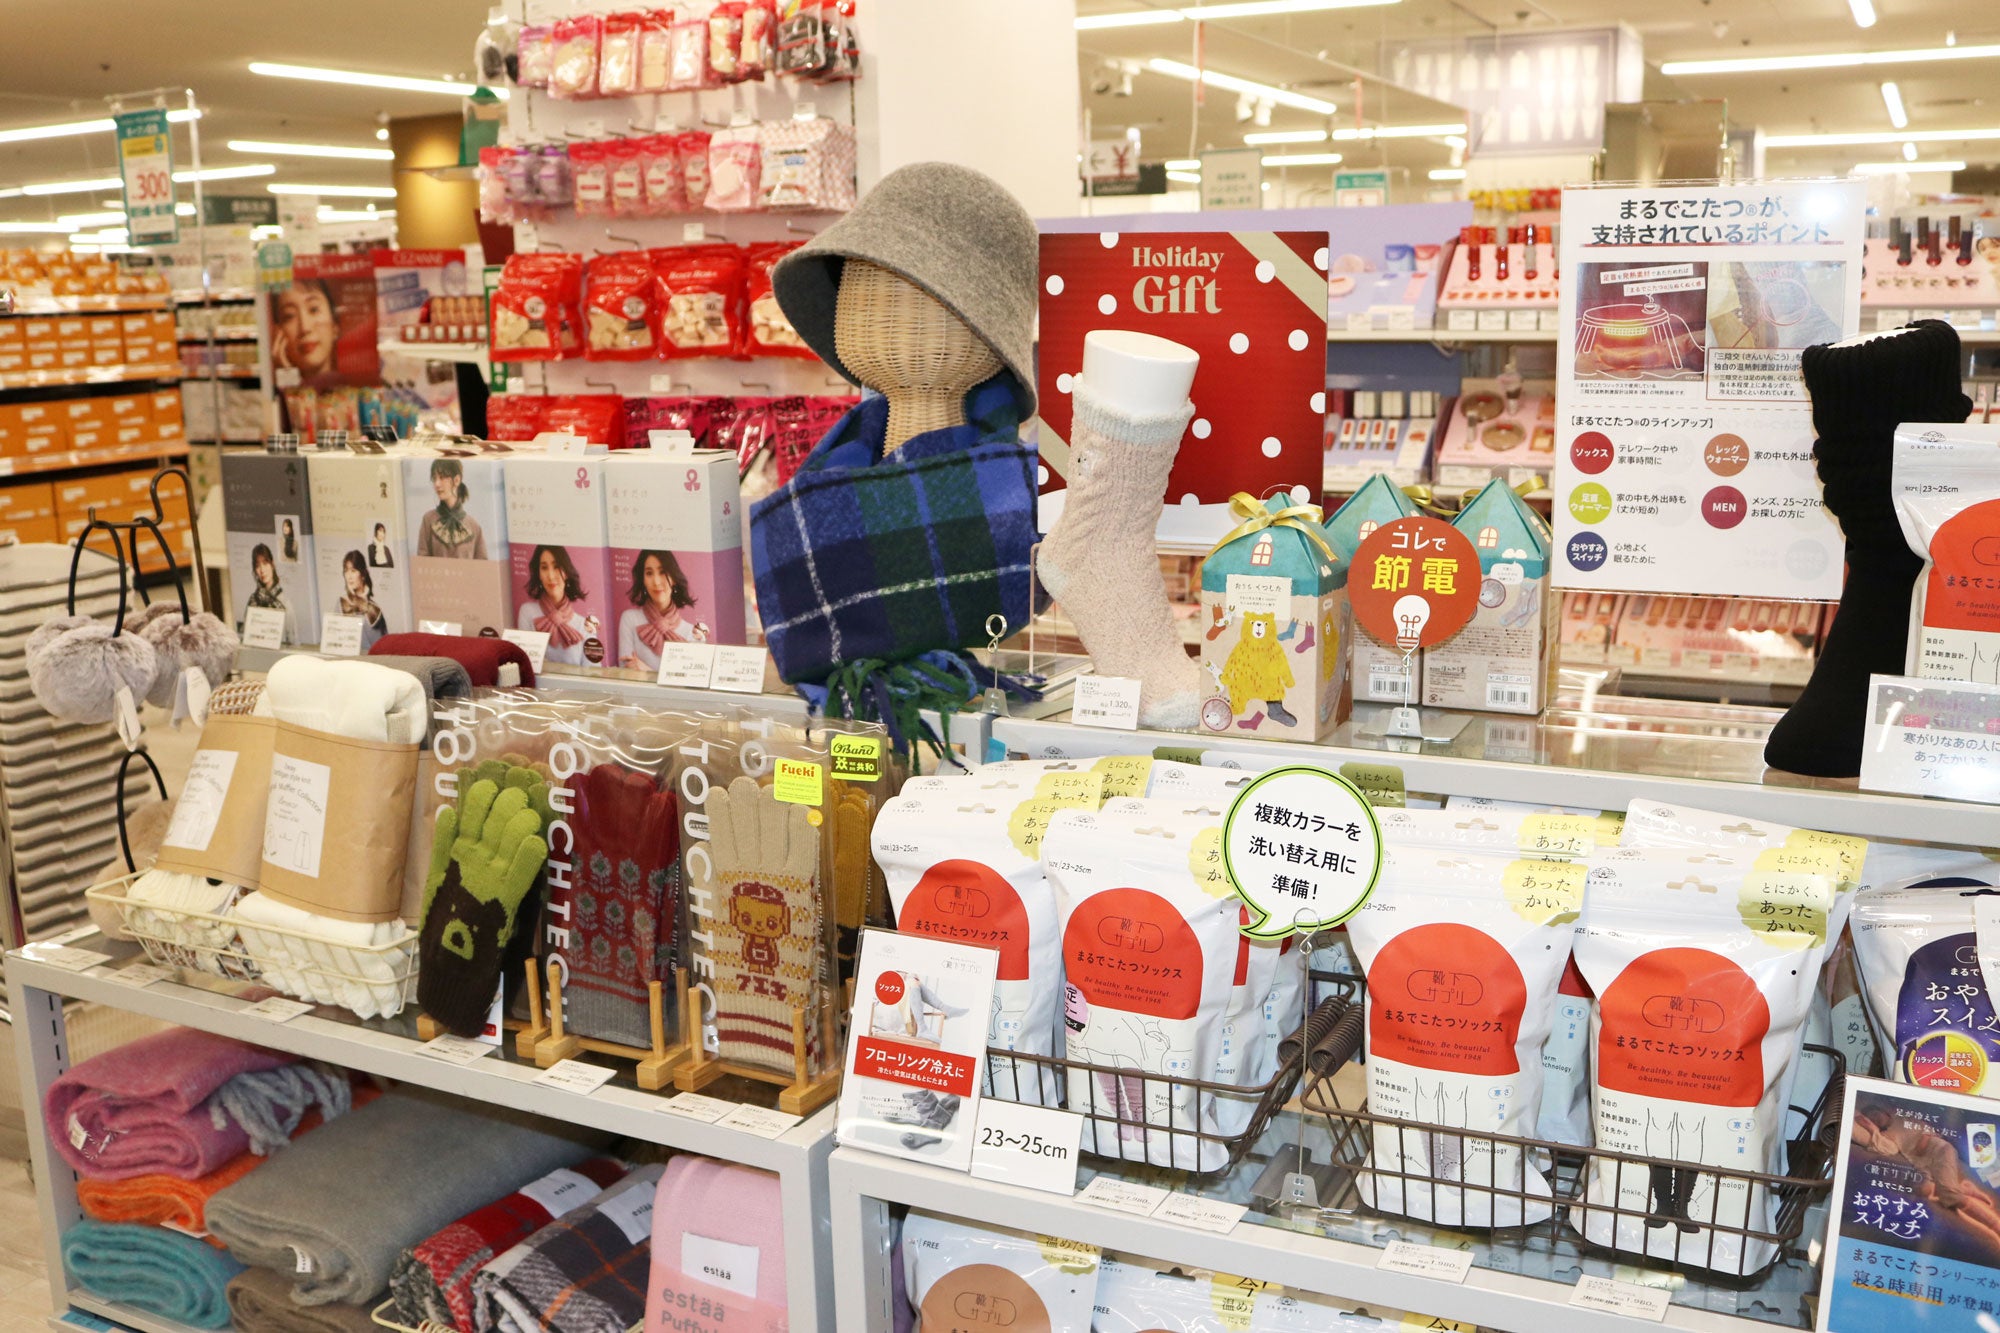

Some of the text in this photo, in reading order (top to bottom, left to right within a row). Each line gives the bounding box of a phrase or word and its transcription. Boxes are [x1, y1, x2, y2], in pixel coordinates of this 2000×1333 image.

[1591, 222, 1829, 245] 支持されているポイント
[393, 251, 444, 264] CEZANNE
[1132, 246, 1225, 272] Holiday
[1132, 274, 1223, 314] Gift
[1575, 447, 1609, 458] ソックス
[1618, 444, 1678, 454] テレワーク中や
[1715, 445, 1740, 454] レッグ
[1617, 455, 1662, 465] 家事時間に
[1706, 454, 1748, 464] ウォーマー
[1616, 493, 1687, 504] 家の中も外出時も
[1570, 502, 1610, 511] ウォーマー
[1616, 504, 1659, 515] (丈が短め)
[1712, 502, 1737, 512] MEN
[1751, 508, 1805, 519] お探しの方に
[1391, 526, 1447, 551] コレで
[1571, 543, 1604, 552] おやすみ
[1614, 543, 1647, 552] 心地よく
[1572, 552, 1602, 562] スイッチ
[1613, 554, 1656, 564] 眠るために
[1371, 554, 1459, 595] 節電
[1923, 662, 1955, 671] つま先から
[781, 763, 815, 778] Fueki
[856, 761, 875, 772] 共和
[1107, 760, 1146, 770] とにかく、
[1053, 777, 1095, 788] とにかく、
[1102, 773, 1139, 786] あった
[1354, 772, 1398, 784] とにかく、
[1254, 802, 1362, 842] 複数カラーを
[1539, 821, 1588, 833] とにかく、
[1536, 835, 1582, 851] あった
[1808, 834, 1859, 849] とにかく、
[1206, 849, 1220, 863] あ
[1248, 835, 1357, 875] 洗い替え用に
[1777, 855, 1830, 868] とにかく、
[1528, 864, 1579, 875] とにかく、
[1271, 873, 1318, 900] 準備!
[1522, 875, 1570, 892] あった
[1761, 882, 1818, 898] とにかく、
[953, 887, 972, 900] 靴下
[949, 901, 976, 918] サプリ
[1525, 894, 1570, 913] かい。
[1759, 899, 1812, 919] あった
[914, 919, 1010, 941] まるでこたつソックス
[1121, 917, 1146, 933] 靴下
[1766, 919, 1816, 936] かい。
[1114, 933, 1148, 951] サプリ
[1077, 950, 1183, 979] まるでこたつソックス
[1433, 970, 1460, 987] 靴下
[1950, 967, 1980, 977] まるで
[878, 982, 901, 993] ソックス
[1125, 984, 1135, 992] Be
[1136, 985, 1171, 998] beautiful.
[1925, 982, 1979, 1006] おや
[1124, 993, 1142, 1001] since
[1426, 985, 1465, 1005] サプリ
[1670, 995, 1699, 1012] 靴下
[1566, 1007, 1583, 1018] 寒さ
[1384, 1009, 1504, 1032] まるでこたつソックス
[1663, 1013, 1706, 1033] サプリ
[1441, 1041, 1452, 1049] Be
[1616, 1035, 1745, 1062] まるでこたつソックス
[1407, 1045, 1482, 1061] okamoto since 1948
[1542, 1054, 1557, 1062] arm
[1915, 1055, 1944, 1064] リラックス
[865, 1047, 964, 1078] フローリング冷えに
[1950, 1058, 1973, 1067] 温める
[877, 1066, 948, 1087] 冷たい空気は足もとにたまる
[1627, 1062, 1733, 1084] Be healthy. Be beautiful.
[1638, 1075, 1722, 1091] okamoto since 1948
[1930, 1078, 1960, 1087] 快眠体温
[1375, 1091, 1401, 1103] つま先から
[1494, 1089, 1510, 1097] 寒さ
[1375, 1104, 1410, 1118] ふくらはぎまで
[1895, 1107, 1940, 1123] 足が冷えて
[1600, 1124, 1629, 1137] つま先から
[1733, 1121, 1751, 1130] 寒さ
[1903, 1120, 1962, 1139] 眠れない方に。
[1470, 1138, 1490, 1146] Warm
[1600, 1138, 1639, 1152] ふくらはぎまで
[1621, 1187, 1642, 1197] Ankle
[1870, 1179, 1913, 1193] まるでこたつ
[1853, 1191, 1930, 1220] おやすみ
[1853, 1210, 1921, 1239] スイッチ
[922, 1240, 940, 1250] FREE
[703, 1265, 731, 1280] estää
[662, 1288, 726, 1322] estää
[975, 1293, 1001, 1308] 靴下
[1093, 1305, 1110, 1314] FREE
[970, 1308, 1001, 1326] サプリ
